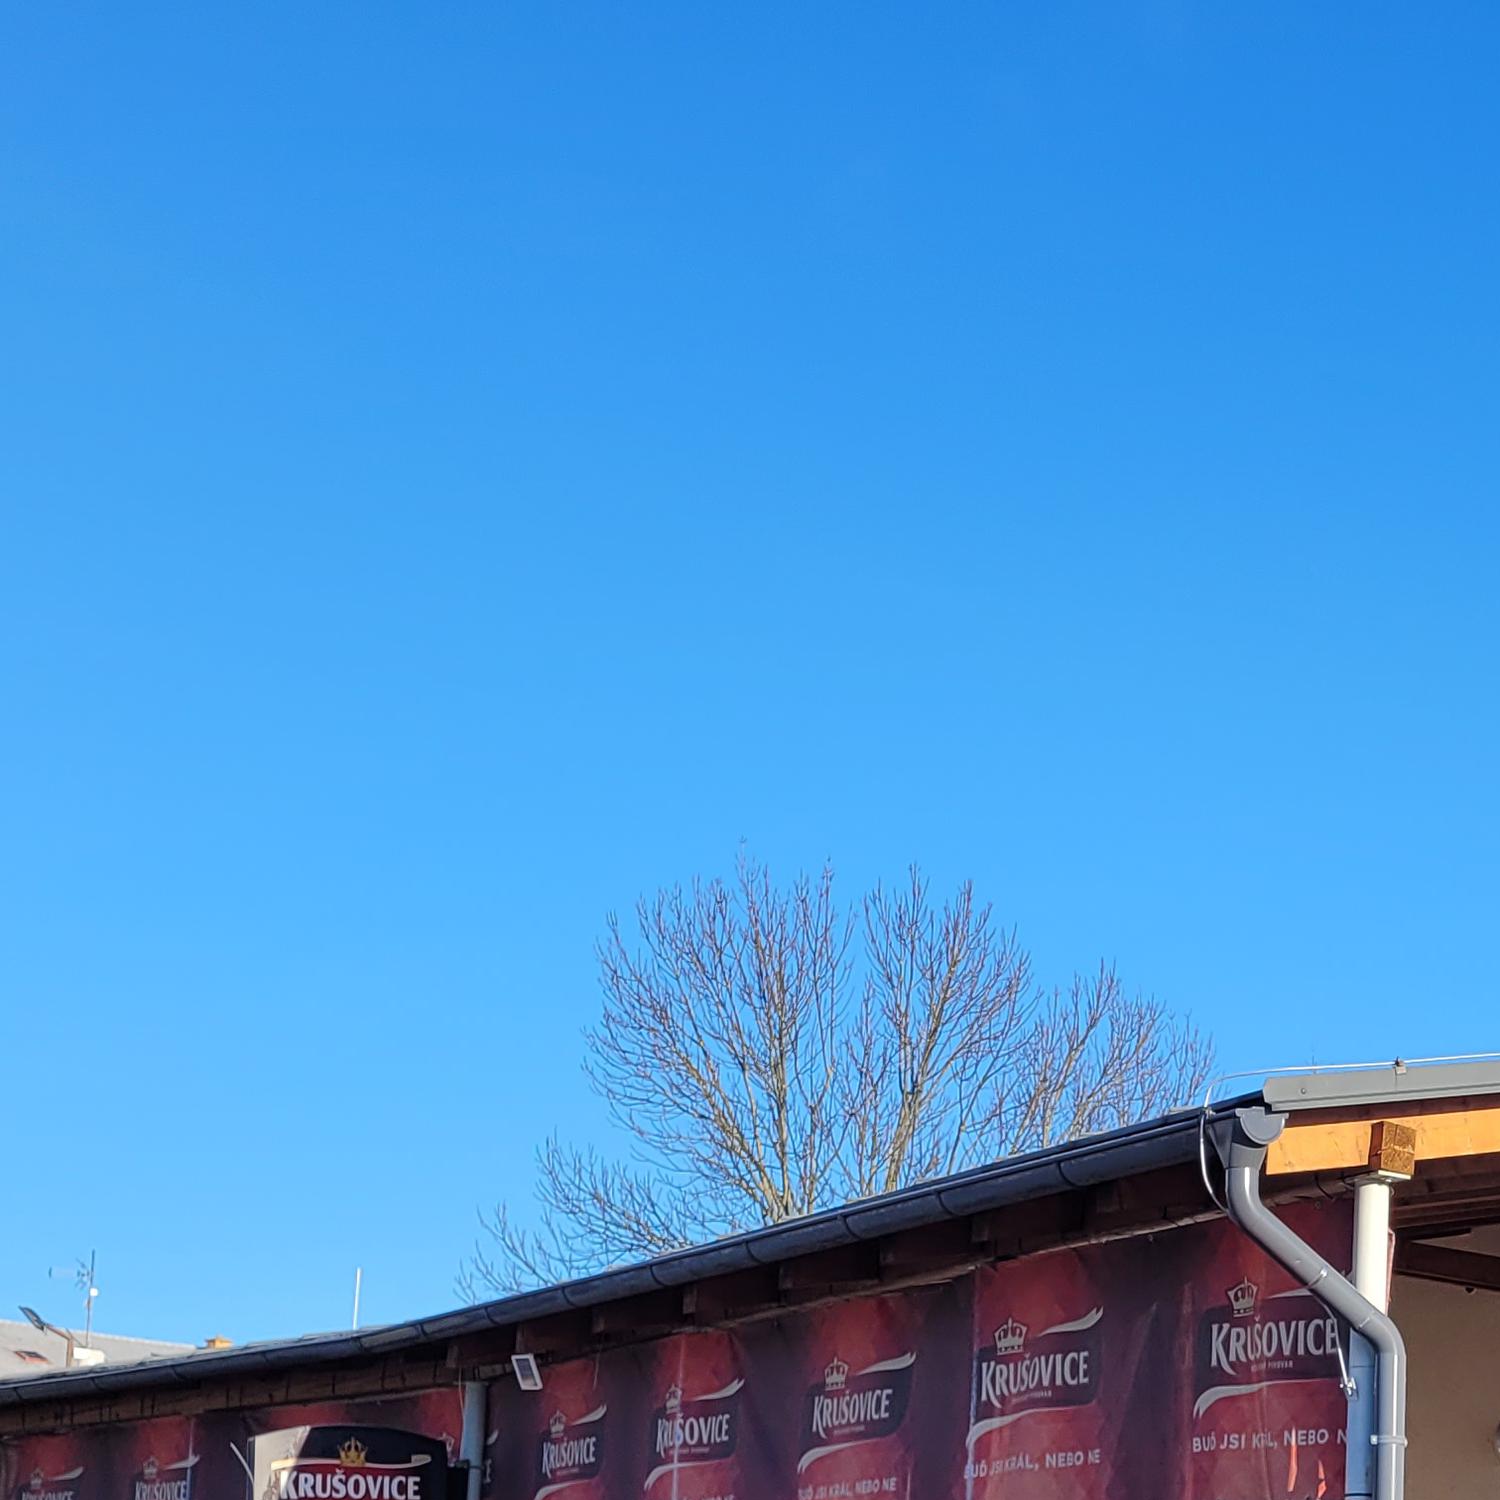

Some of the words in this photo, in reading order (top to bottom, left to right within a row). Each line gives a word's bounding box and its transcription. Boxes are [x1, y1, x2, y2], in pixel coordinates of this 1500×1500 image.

[981, 1351, 1090, 1409] KRUŠOVICE
[812, 1388, 893, 1440] KRUŠOVICE
[541, 1436, 597, 1479] KRUŠOVICE
[656, 1413, 730, 1459] KRUŠOVICE
[1192, 1431, 1216, 1453] BUĎ
[1219, 1434, 1247, 1450] JSI
[1283, 1429, 1329, 1447] NEBO
[1045, 1451, 1084, 1468] NEBO
[1087, 1449, 1101, 1464] NE
[280, 1468, 421, 1500] KRUŠOVICE
